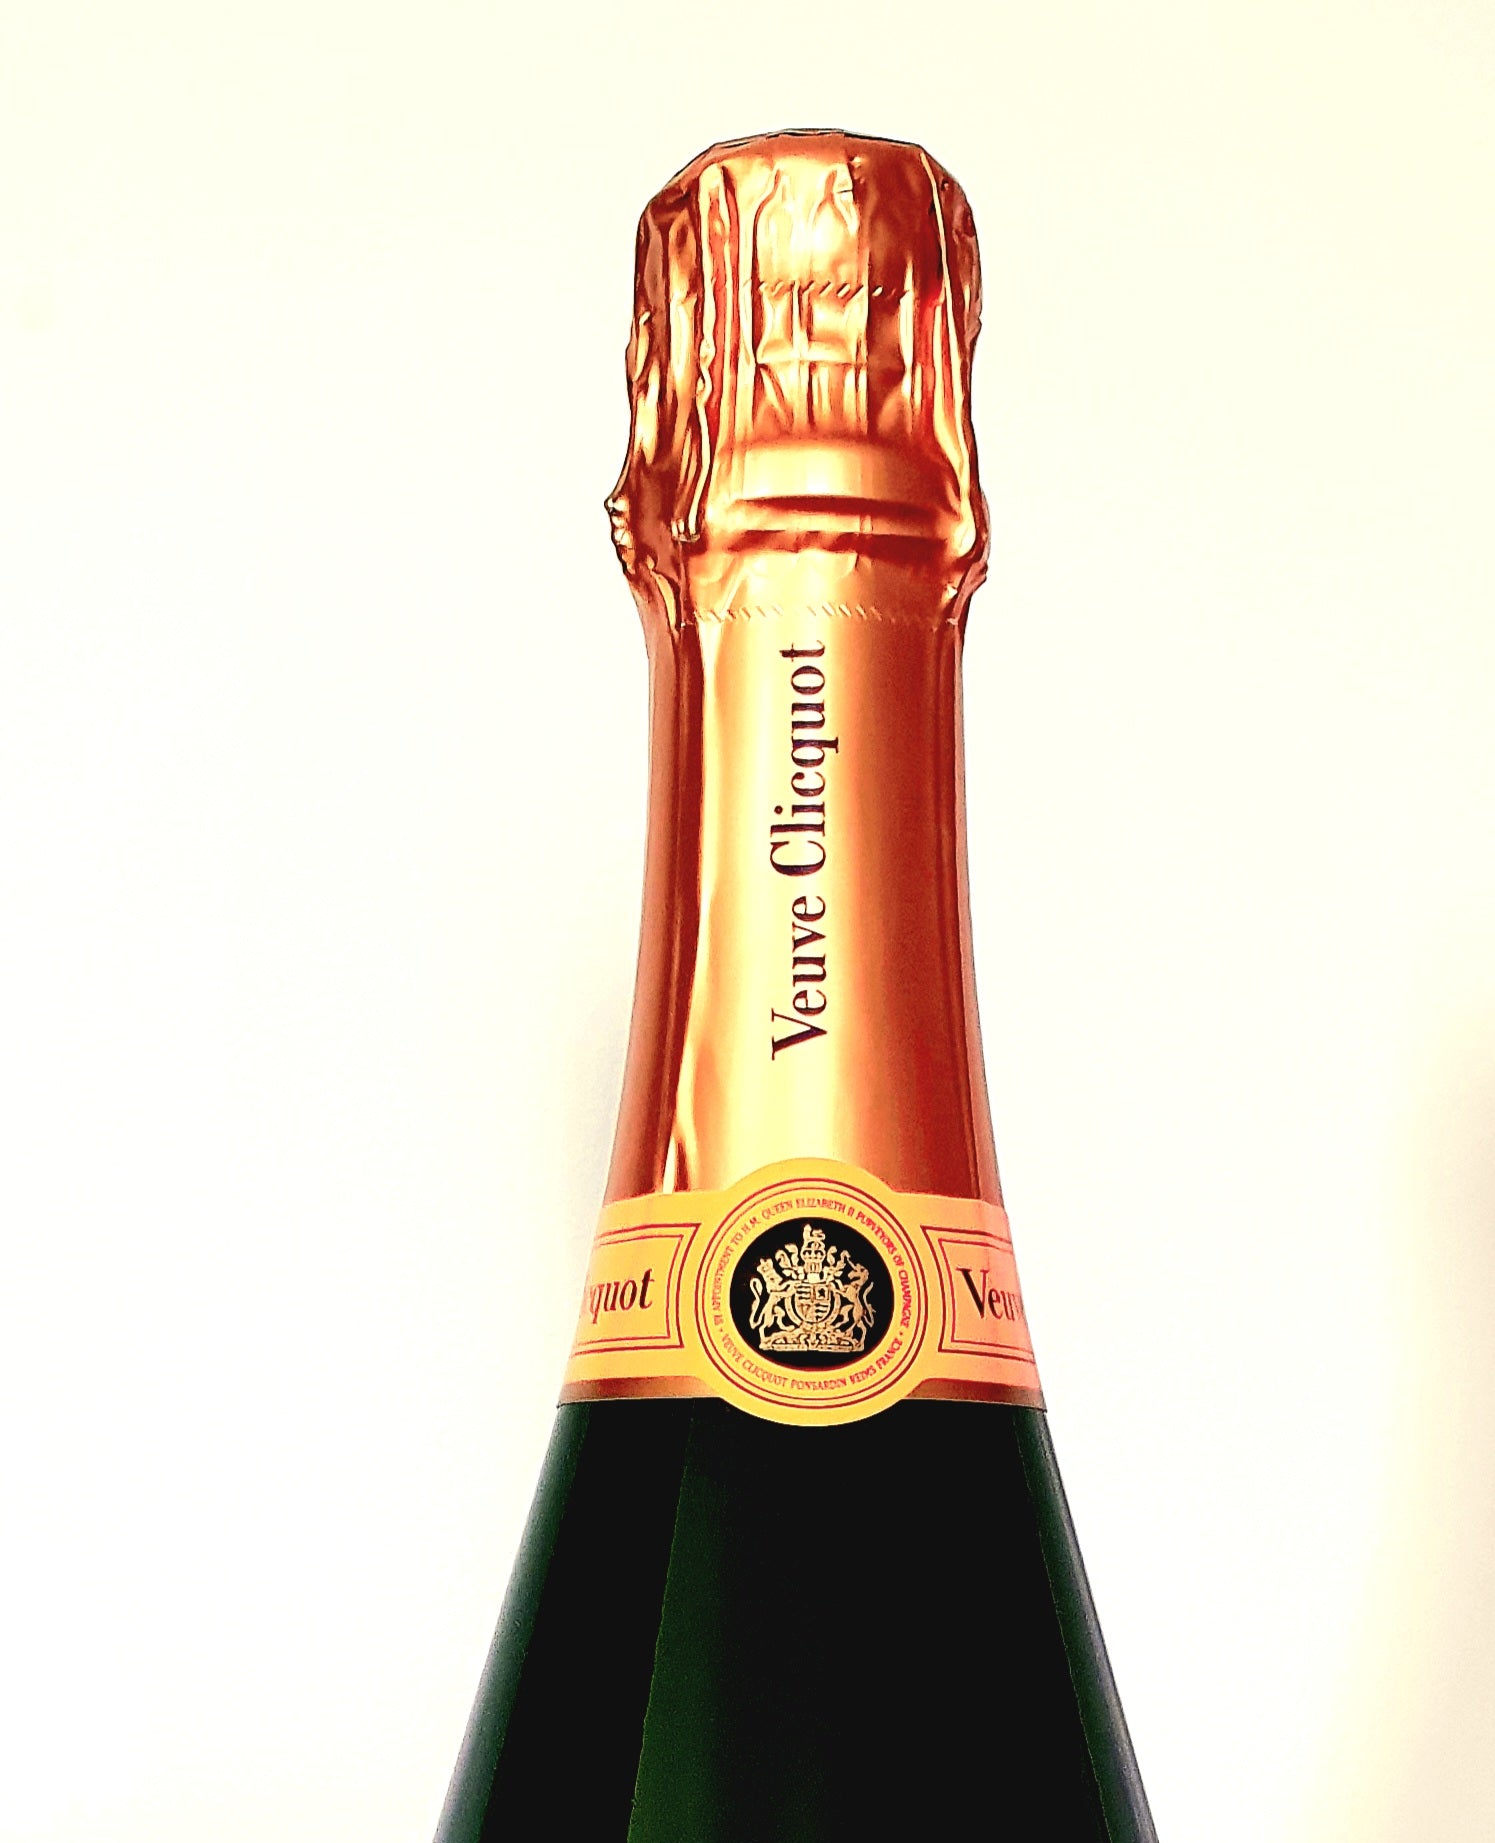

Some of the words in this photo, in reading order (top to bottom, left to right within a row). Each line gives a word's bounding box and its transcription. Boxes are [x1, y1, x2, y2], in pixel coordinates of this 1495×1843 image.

[770, 639, 839, 877] Clicquot
[770, 895, 828, 1061] Veuve
[761, 1200, 793, 1220] QUEEN
